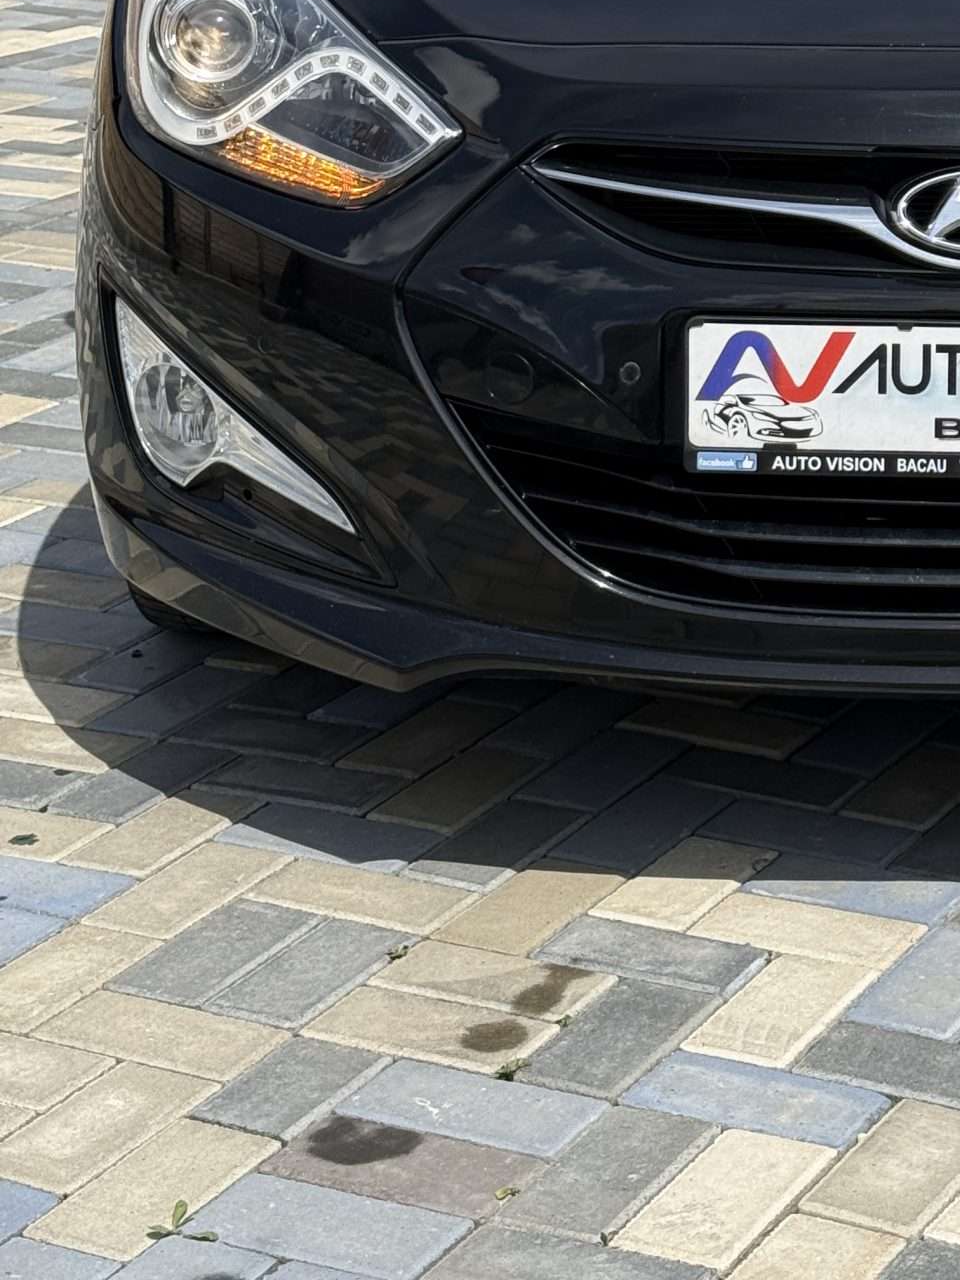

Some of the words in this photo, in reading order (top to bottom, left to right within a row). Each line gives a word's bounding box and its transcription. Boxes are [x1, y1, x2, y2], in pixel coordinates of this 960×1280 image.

[699, 456, 735, 468] facebook
[771, 455, 822, 470] AUTO
[825, 456, 885, 472] VISION
[896, 457, 947, 473] BACAU
